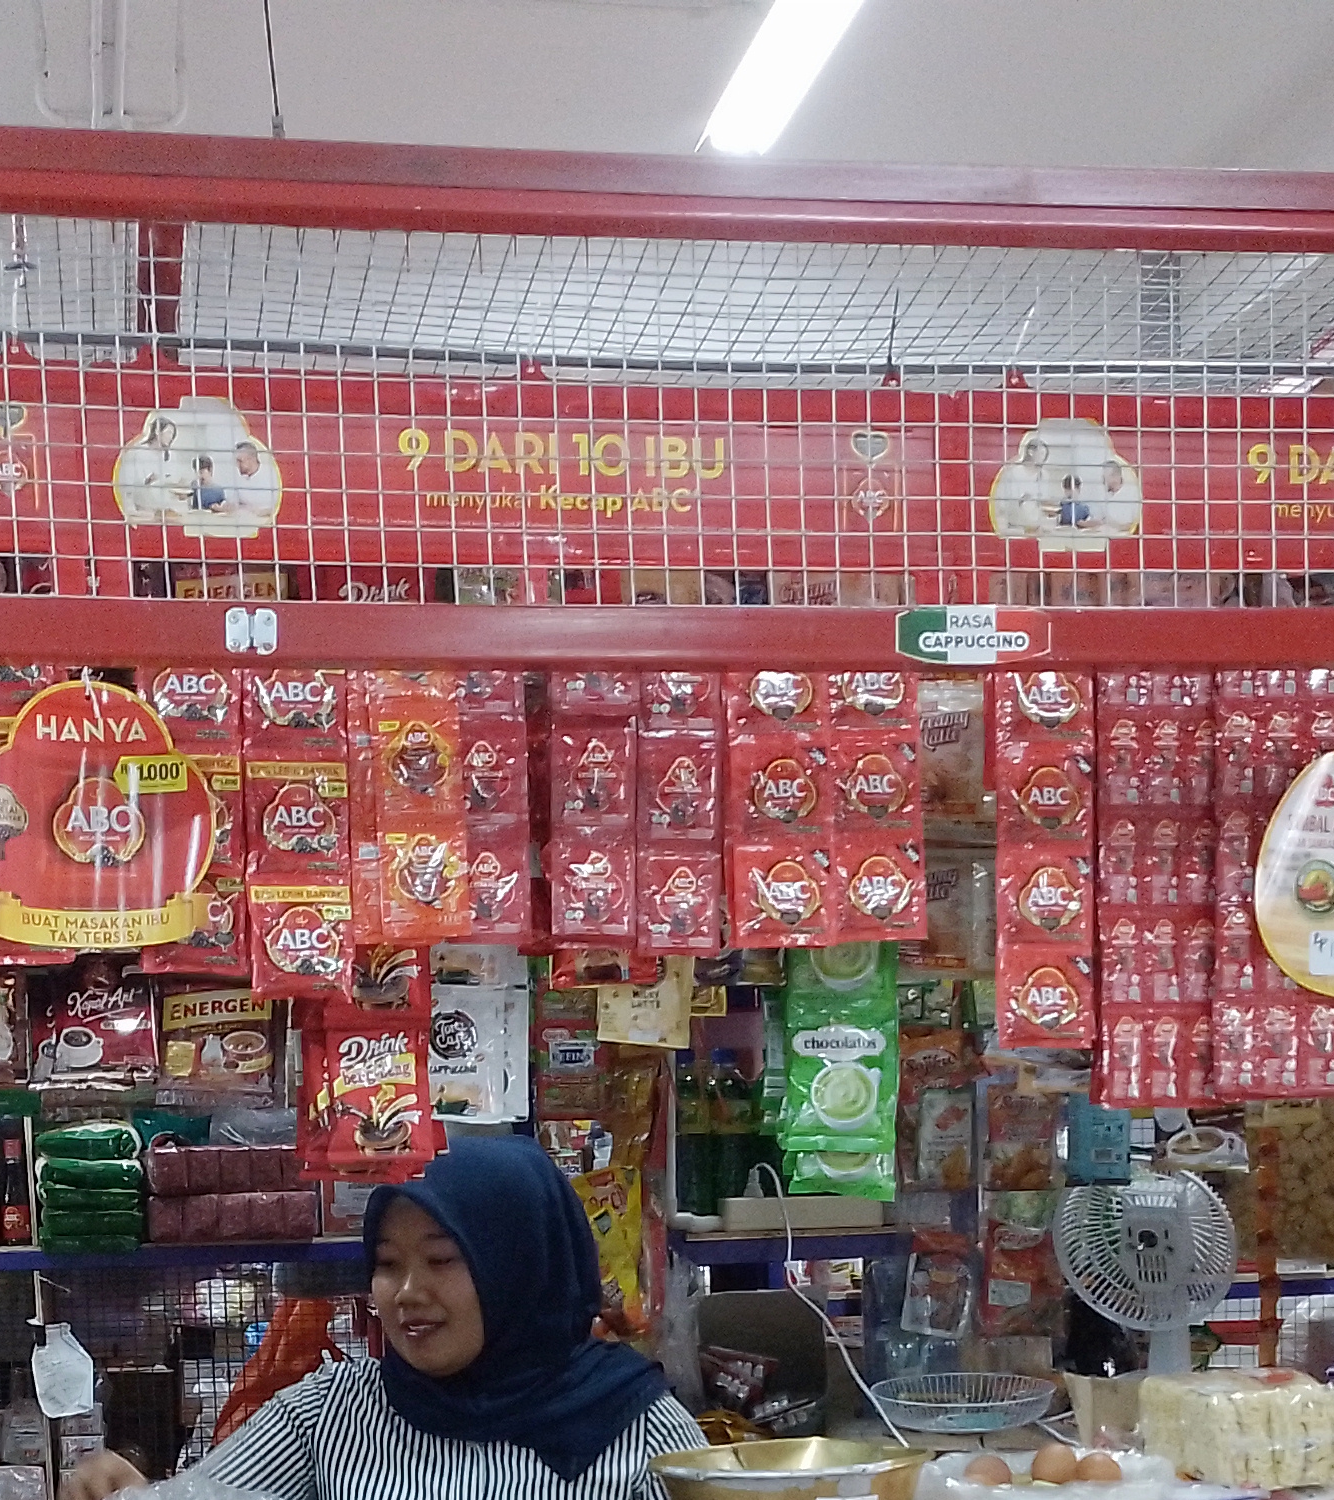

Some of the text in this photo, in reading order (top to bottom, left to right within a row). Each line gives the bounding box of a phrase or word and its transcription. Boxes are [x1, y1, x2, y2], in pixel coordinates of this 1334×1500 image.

[445, 430, 557, 474] DARI
[573, 434, 629, 477] 10
[646, 437, 725, 479] IBU
[540, 485, 622, 516] Kecap
[922, 632, 1028, 650] CAPPUCCINO
[36, 714, 147, 742] HANYA
[67, 806, 134, 832] ABC
[169, 998, 267, 1021] ENERGEN
[338, 1032, 410, 1069] Drink
